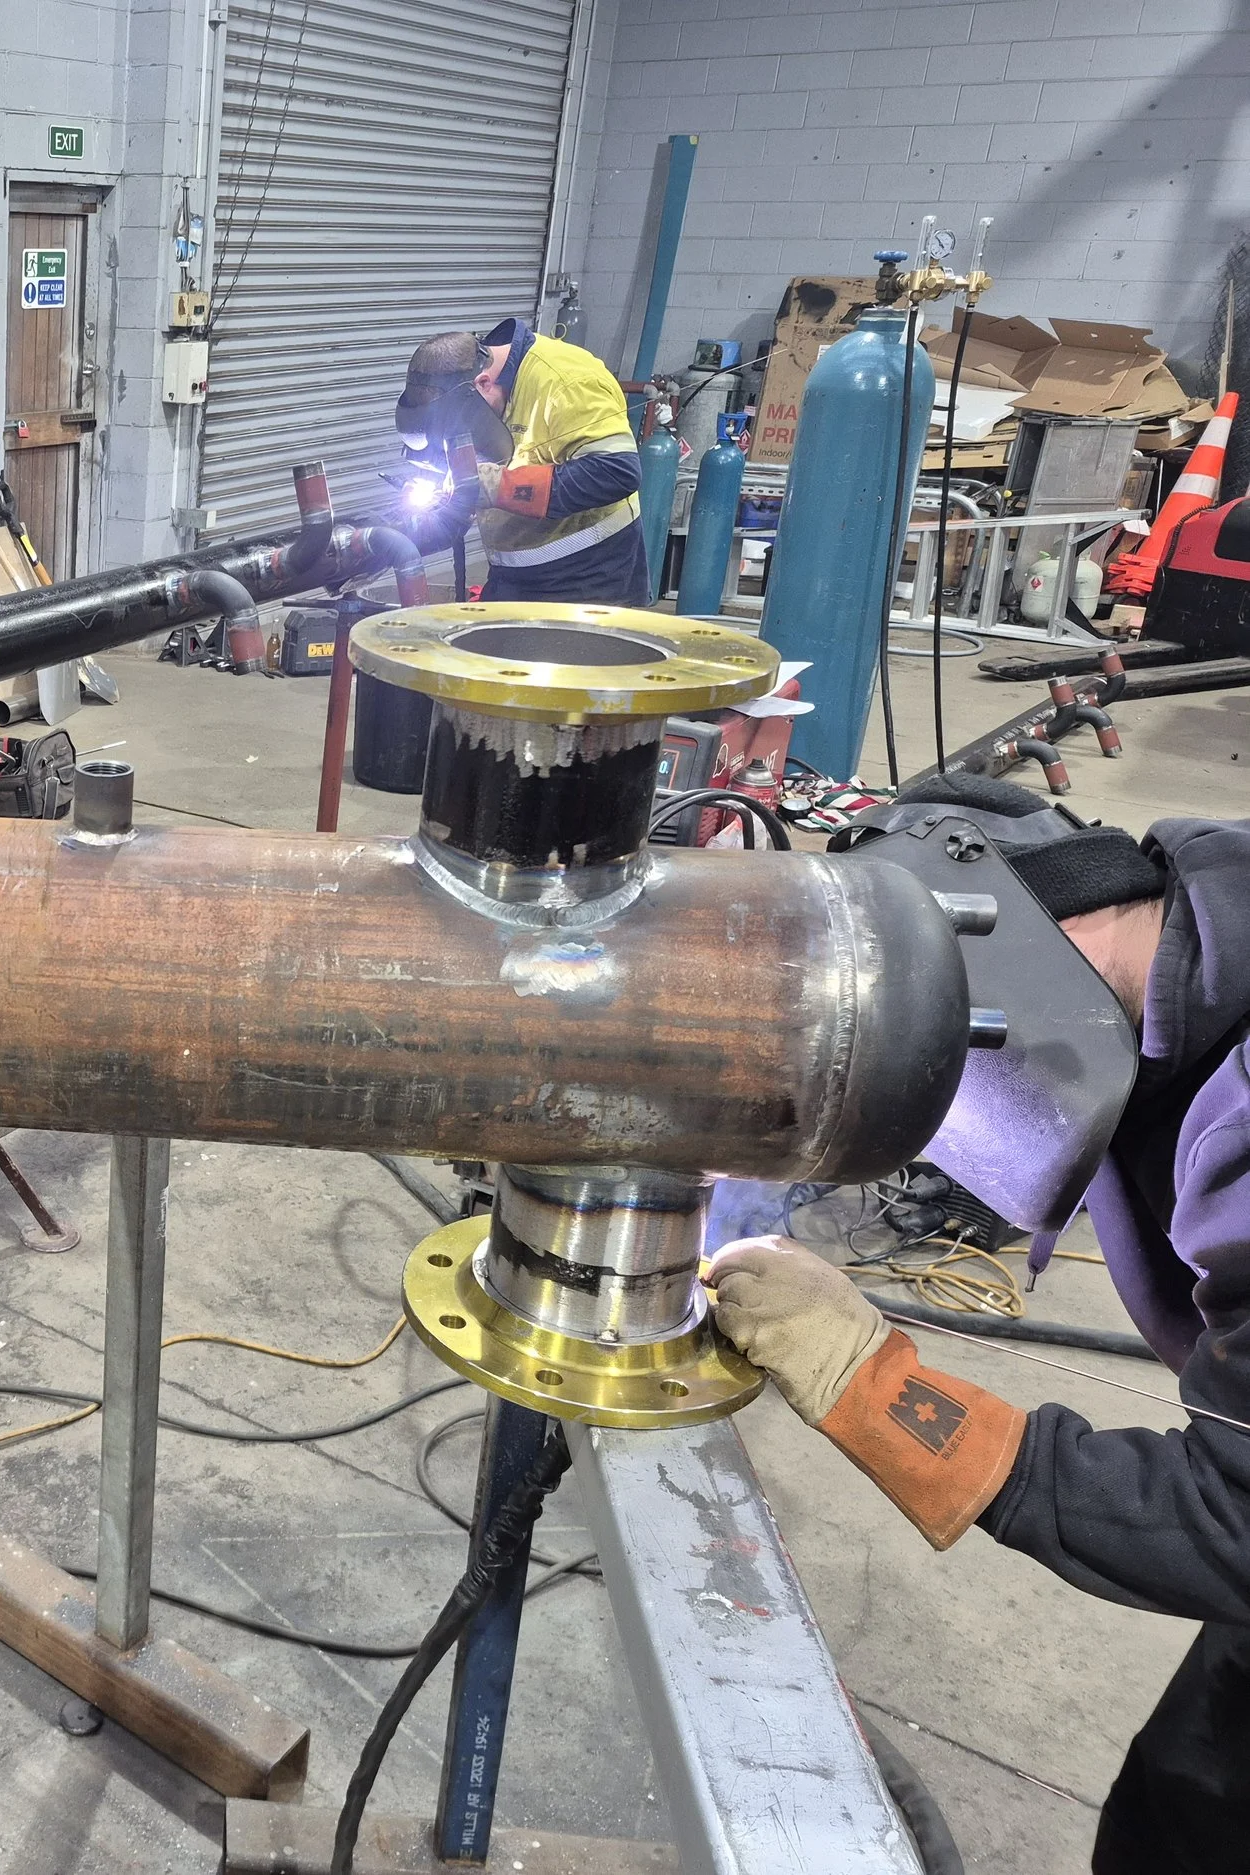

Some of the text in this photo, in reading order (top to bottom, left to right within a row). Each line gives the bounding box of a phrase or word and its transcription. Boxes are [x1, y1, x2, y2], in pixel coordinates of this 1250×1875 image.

[55, 132, 78, 151] EXIT
[42, 256, 62, 265] Emergency
[52, 293, 63, 301] TIMES
[766, 404, 798, 420] MA
[761, 427, 796, 444] PRI
[758, 449, 792, 458] Indoor/
[941, 1438, 961, 1461] BLUE
[462, 1812, 479, 1846] MILLS
